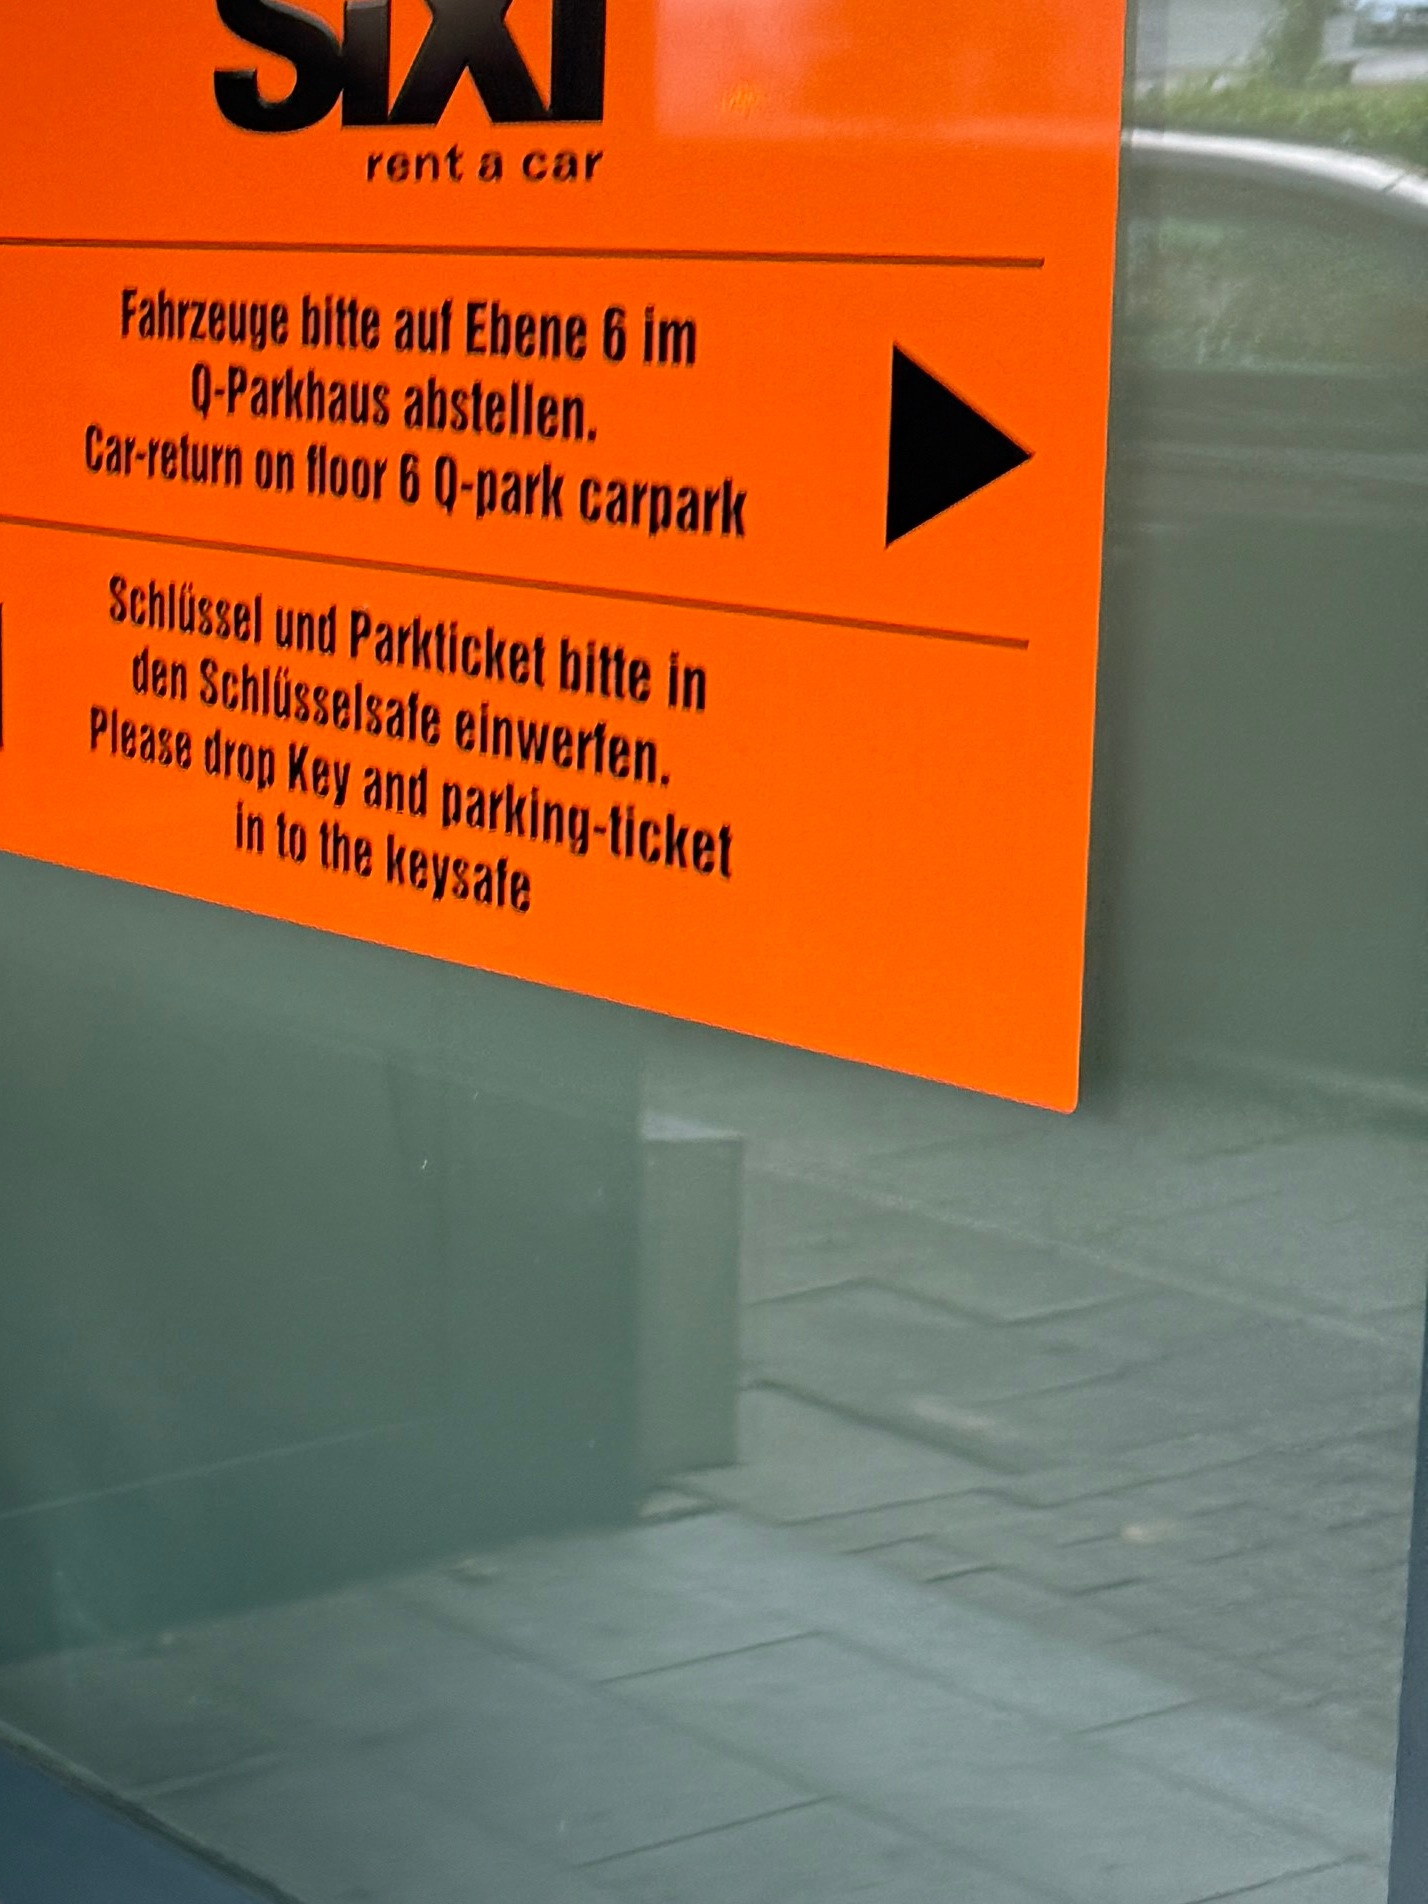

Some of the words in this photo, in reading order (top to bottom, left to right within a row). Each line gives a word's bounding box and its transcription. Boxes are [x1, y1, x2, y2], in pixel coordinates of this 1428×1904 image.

[366, 144, 464, 183] rent
[478, 151, 503, 182] a
[522, 149, 603, 183] car
[120, 287, 289, 350] Fahrzeuge
[301, 292, 381, 350] bitte
[394, 297, 452, 353] auf
[465, 299, 587, 360] Ebene
[602, 305, 626, 364] 6
[643, 303, 696, 366] im
[191, 361, 390, 428] Q-Parkhaus
[403, 375, 598, 442] abstellen.
[85, 424, 243, 487] Car-return
[255, 447, 295, 493] on
[306, 442, 388, 501] floor
[399, 450, 421, 505] 6
[434, 454, 565, 519] Q-park
[579, 475, 747, 538] carpark
[109, 573, 262, 645] Schlüssel
[275, 604, 337, 656] und
[350, 607, 546, 690] Parkticket
[559, 635, 652, 703] bitte
[667, 649, 706, 712] in
[132, 645, 187, 701] den
[199, 656, 441, 746] Schlüsselsafe
[455, 700, 670, 786] einwerfen.
[90, 704, 193, 771] Please
[204, 728, 276, 791] drop
[288, 742, 351, 807] Key
[363, 765, 428, 817] and
[441, 777, 734, 880] parking-ticket
[236, 799, 265, 854] in
[276, 811, 307, 864] to
[320, 818, 373, 877] the
[386, 832, 532, 914] keysafe
